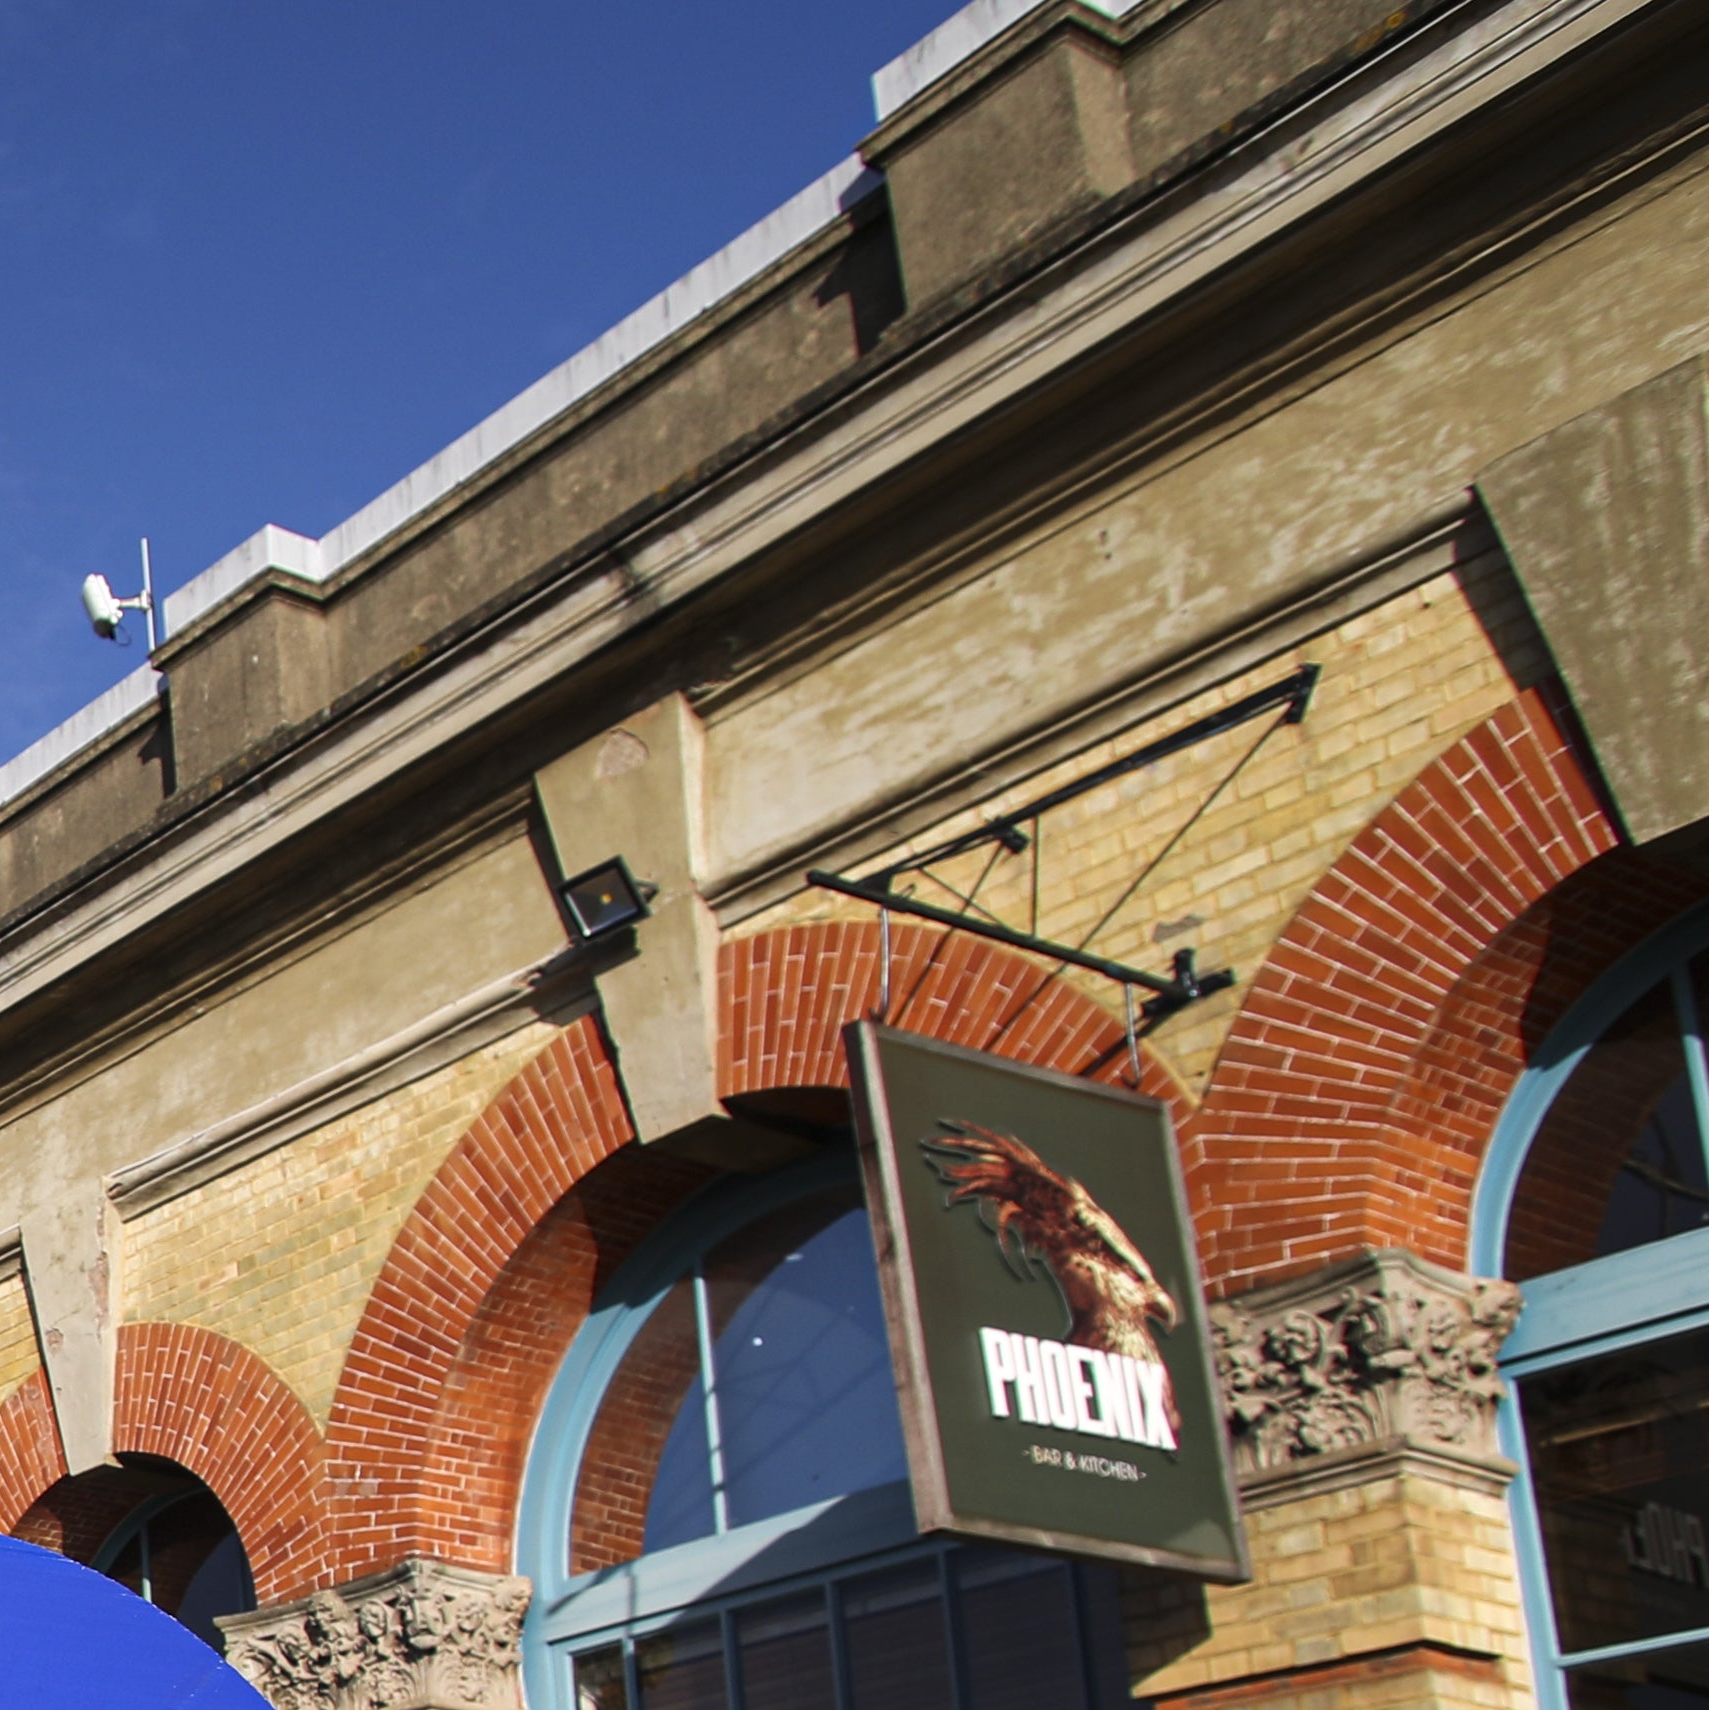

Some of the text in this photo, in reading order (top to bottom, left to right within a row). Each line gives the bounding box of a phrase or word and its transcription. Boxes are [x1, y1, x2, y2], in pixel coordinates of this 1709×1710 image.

[980, 1327, 1178, 1449] PHOENIX
[1030, 1445, 1139, 1482] BAR & KITCHEN
